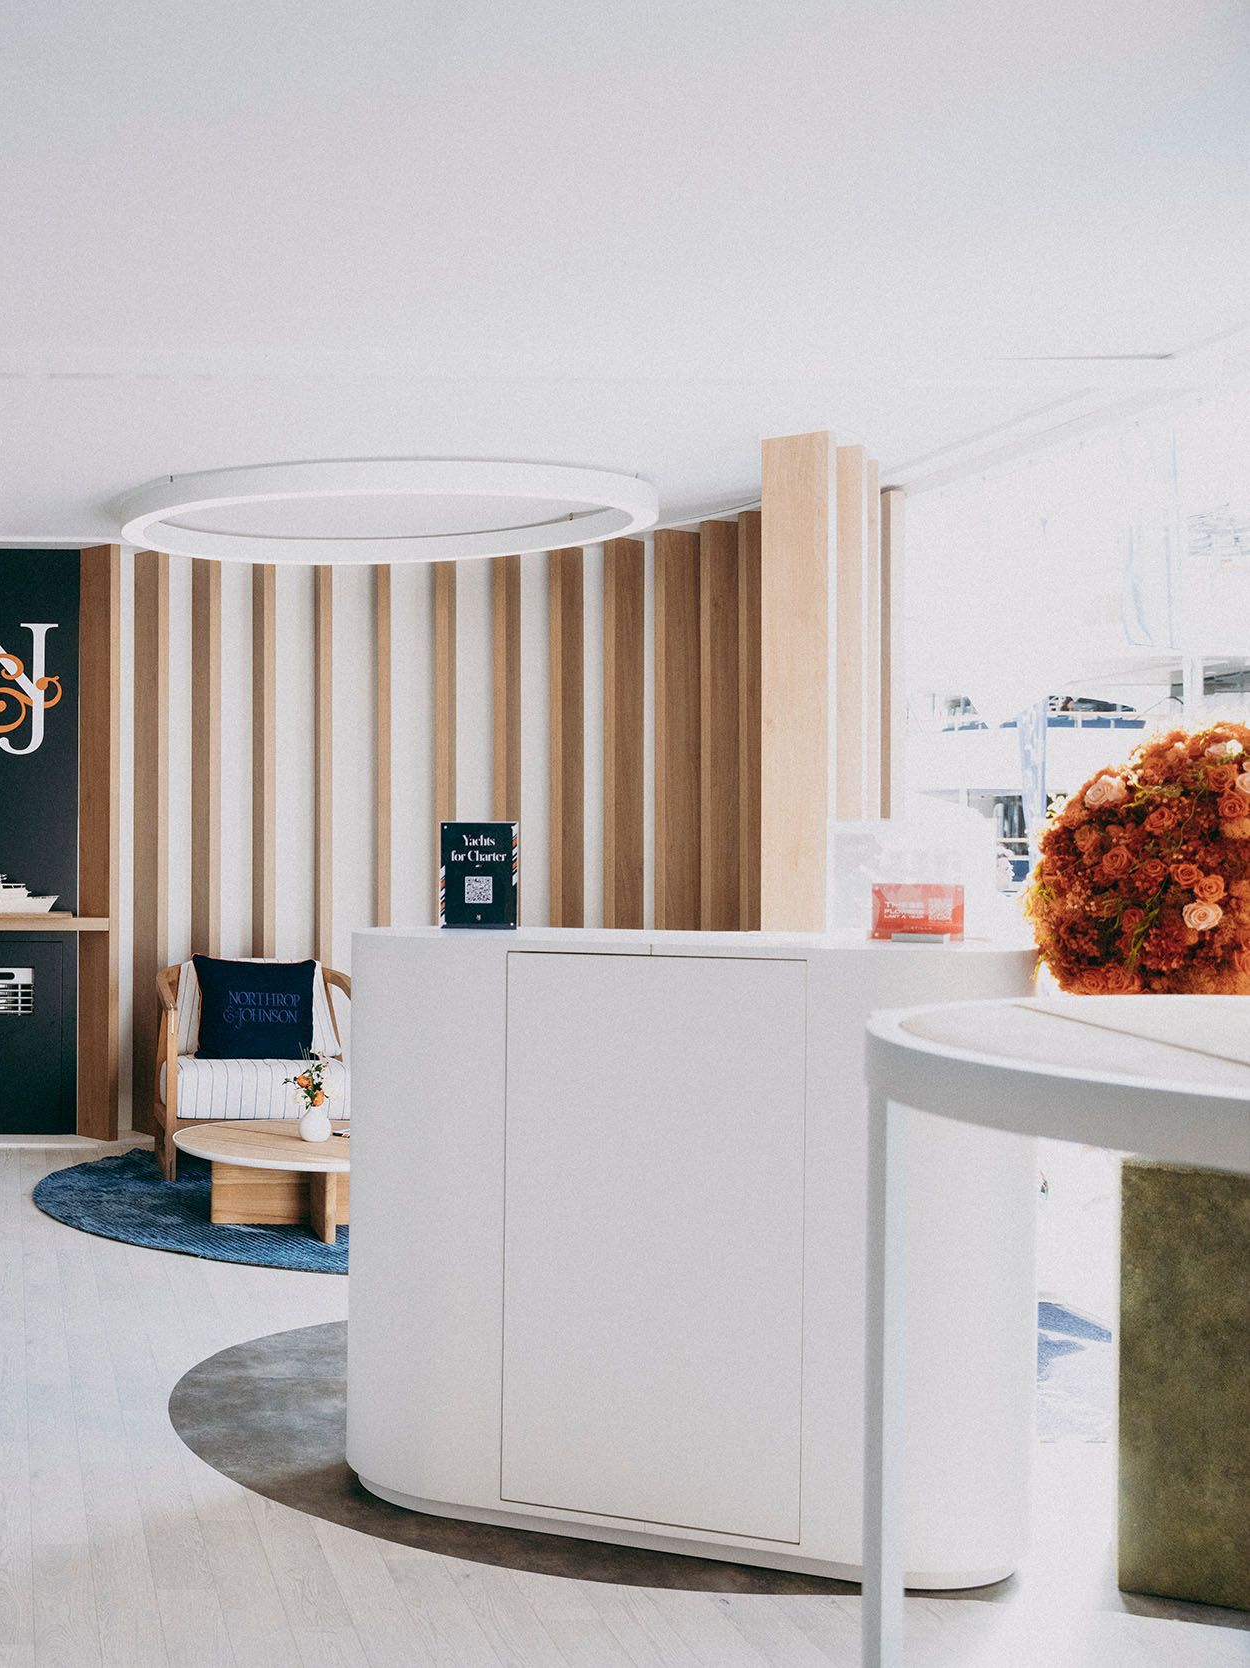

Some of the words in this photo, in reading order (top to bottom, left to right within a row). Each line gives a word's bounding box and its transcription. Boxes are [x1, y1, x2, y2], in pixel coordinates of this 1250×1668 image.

[462, 834, 495, 846] Yachts
[451, 850, 465, 861] for
[467, 850, 507, 861] Charter
[228, 991, 300, 1007] NORTHROP
